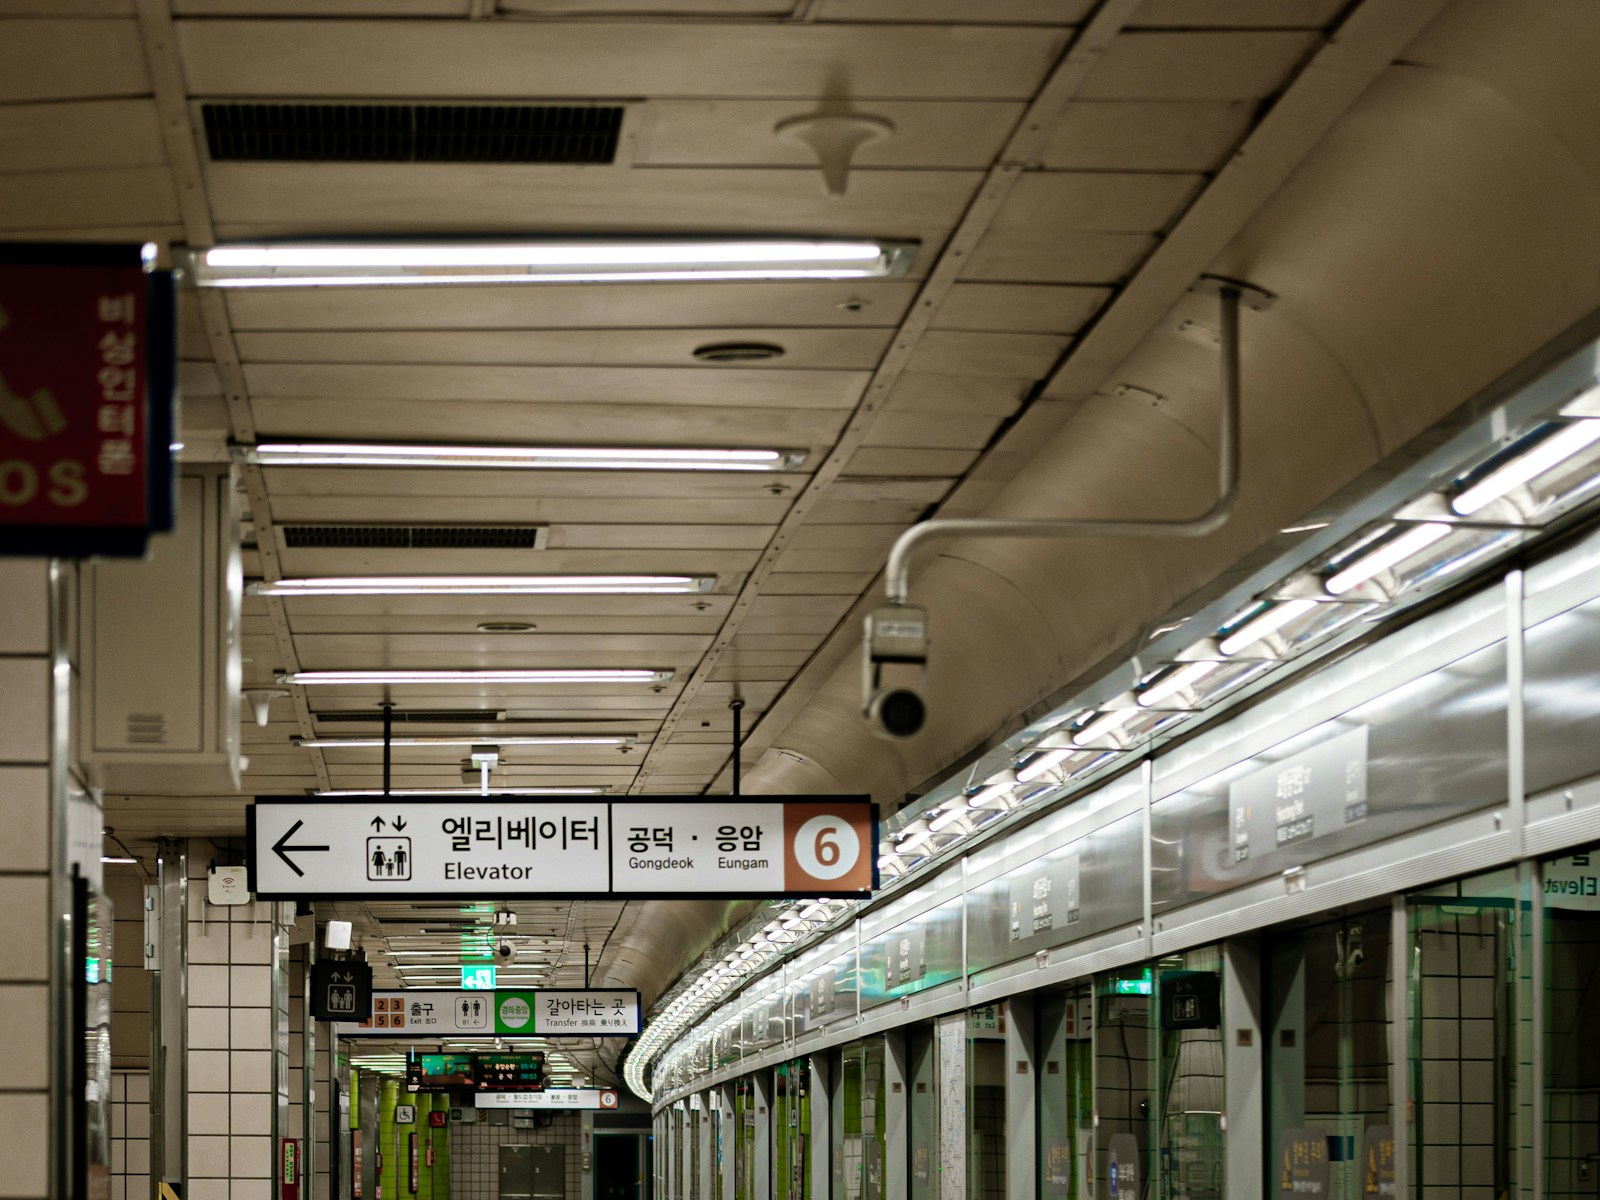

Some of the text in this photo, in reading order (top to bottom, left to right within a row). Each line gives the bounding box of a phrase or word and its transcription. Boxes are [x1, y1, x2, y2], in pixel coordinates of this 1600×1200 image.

[441, 816, 599, 852] 엘리베이터
[627, 826, 673, 853] 공덕
[715, 825, 763, 852] 응암
[814, 827, 841, 867] 6
[444, 861, 533, 880] Elevator
[628, 856, 769, 871] Gongdeok Eungam
[377, 1000, 401, 1010] 2 3
[410, 1002, 435, 1017] 출구
[547, 998, 626, 1016] 갈아타는 곳
[378, 1016, 385, 1025] 5
[393, 1016, 401, 1025] 6
[545, 1018, 578, 1027] Transfer
